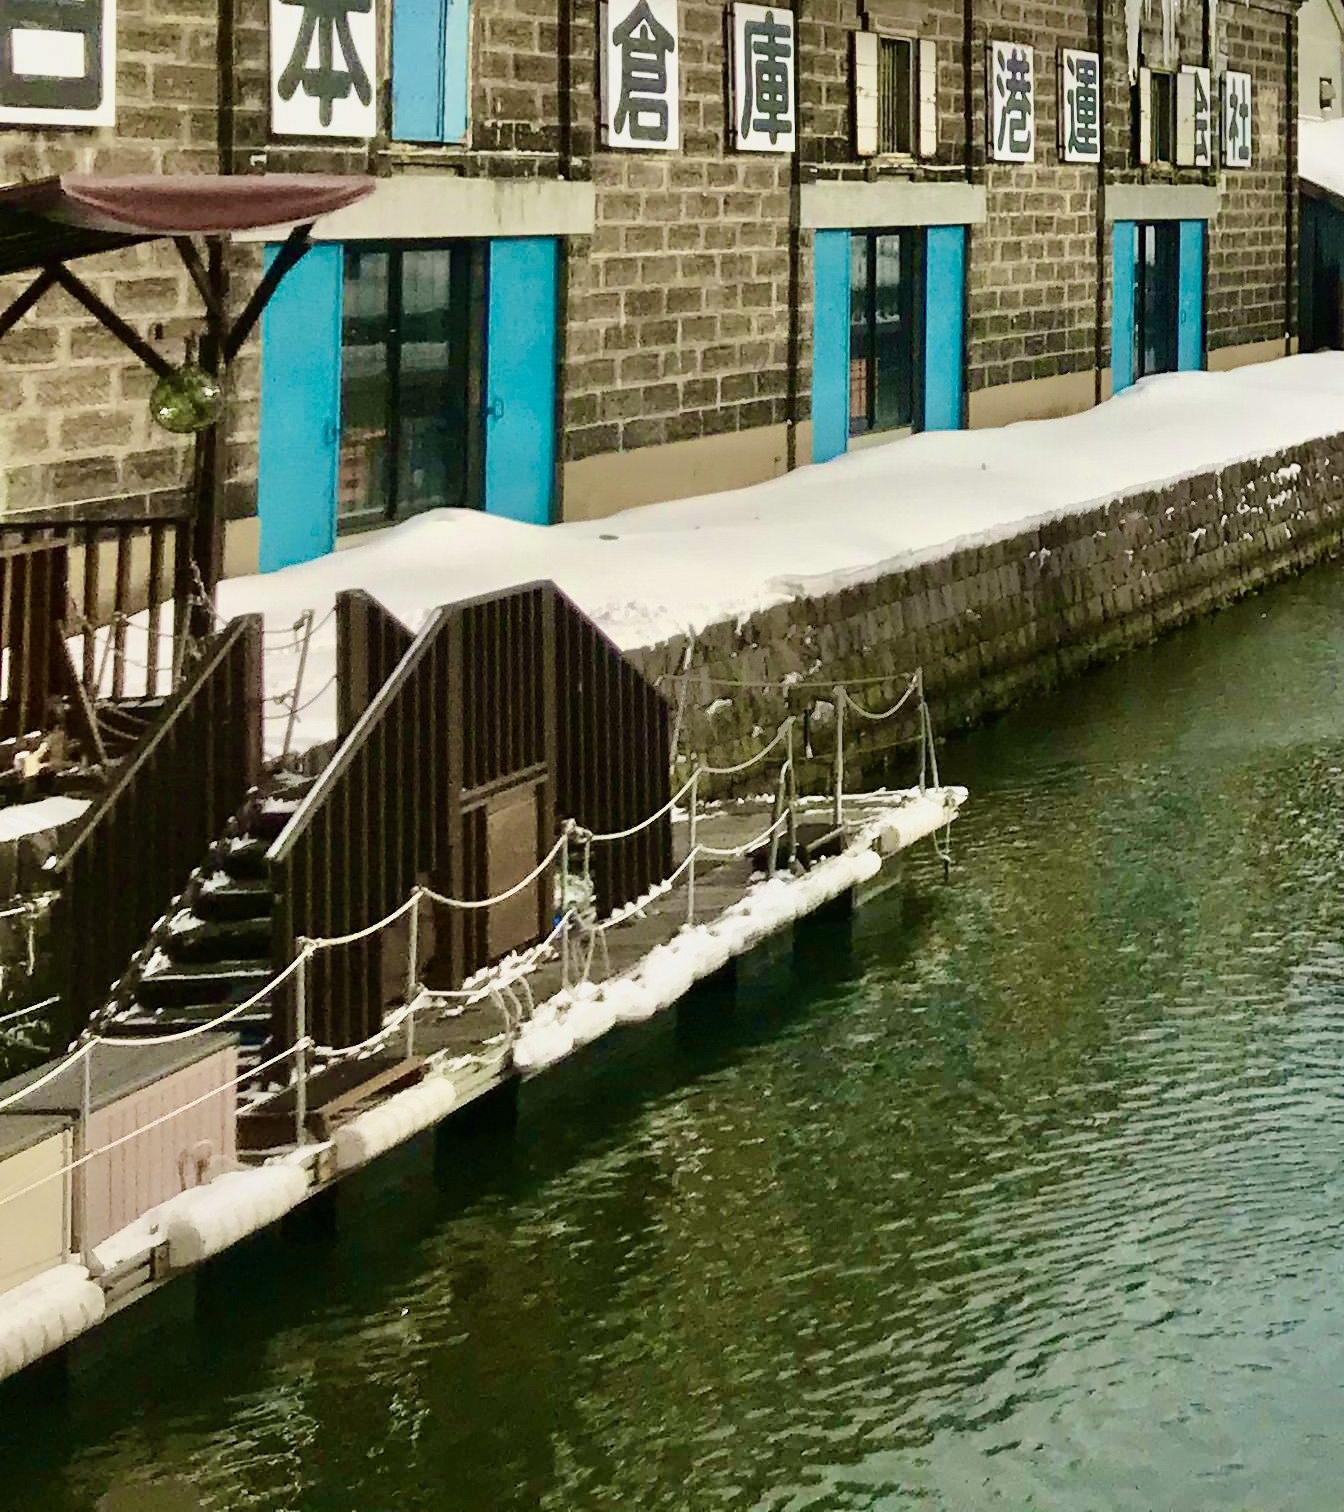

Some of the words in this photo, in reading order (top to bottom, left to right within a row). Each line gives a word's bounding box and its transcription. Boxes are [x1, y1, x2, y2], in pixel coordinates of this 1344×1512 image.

[741, 11, 793, 145] 庫
[995, 47, 1033, 155] 港
[1066, 56, 1098, 155] 運
[1228, 76, 1250, 161] 社
